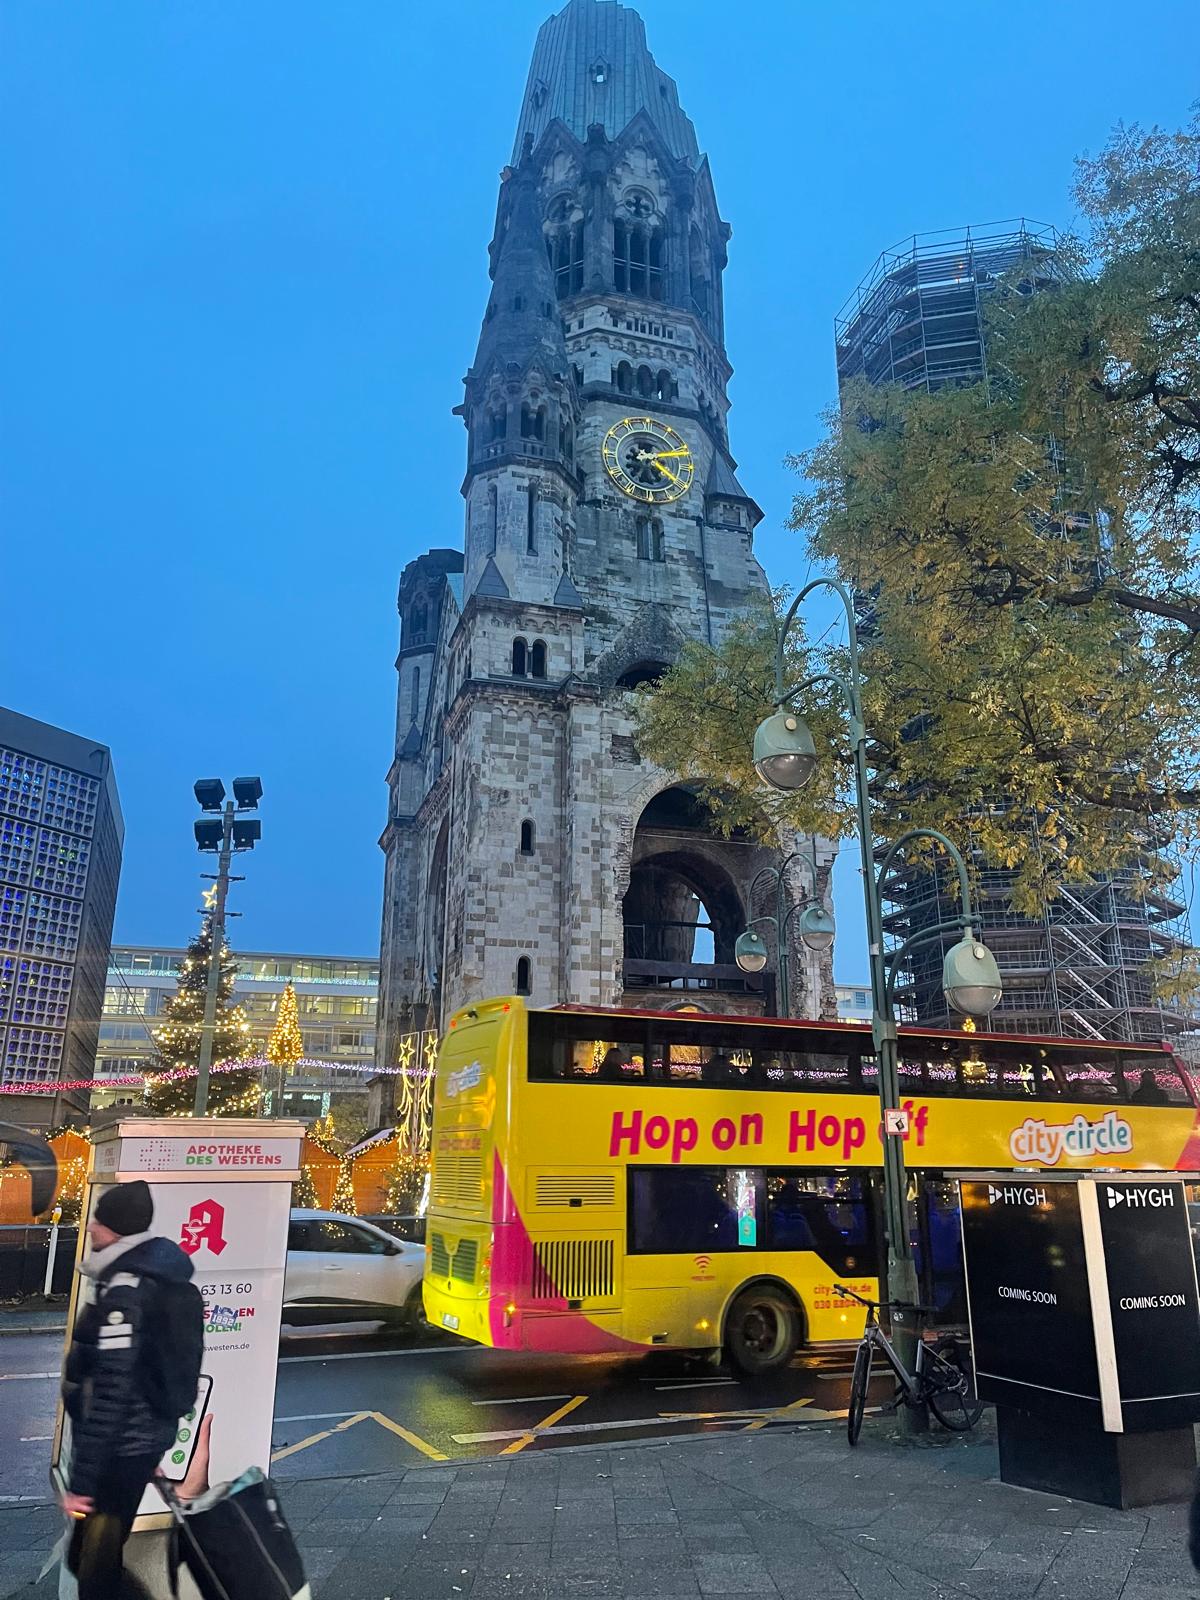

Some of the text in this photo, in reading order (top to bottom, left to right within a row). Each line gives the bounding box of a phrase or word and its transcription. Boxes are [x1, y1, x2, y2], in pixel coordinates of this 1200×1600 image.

[609, 1110, 699, 1163] Hop
[711, 1113, 763, 1151] on
[788, 1109, 866, 1160] Hop
[1013, 1119, 1128, 1159] city circle
[187, 1145, 262, 1155] APOTHEKE
[185, 1155, 282, 1165] DES WESTENS
[1003, 1187, 1047, 1206] HYGH
[1125, 1188, 1175, 1208] HYGH
[201, 1283, 252, 1296] 63 13 60
[998, 1286, 1057, 1305] COMING SOON
[1120, 1294, 1186, 1310] COMING SOON
[203, 1342, 250, 1351] swestens.de
